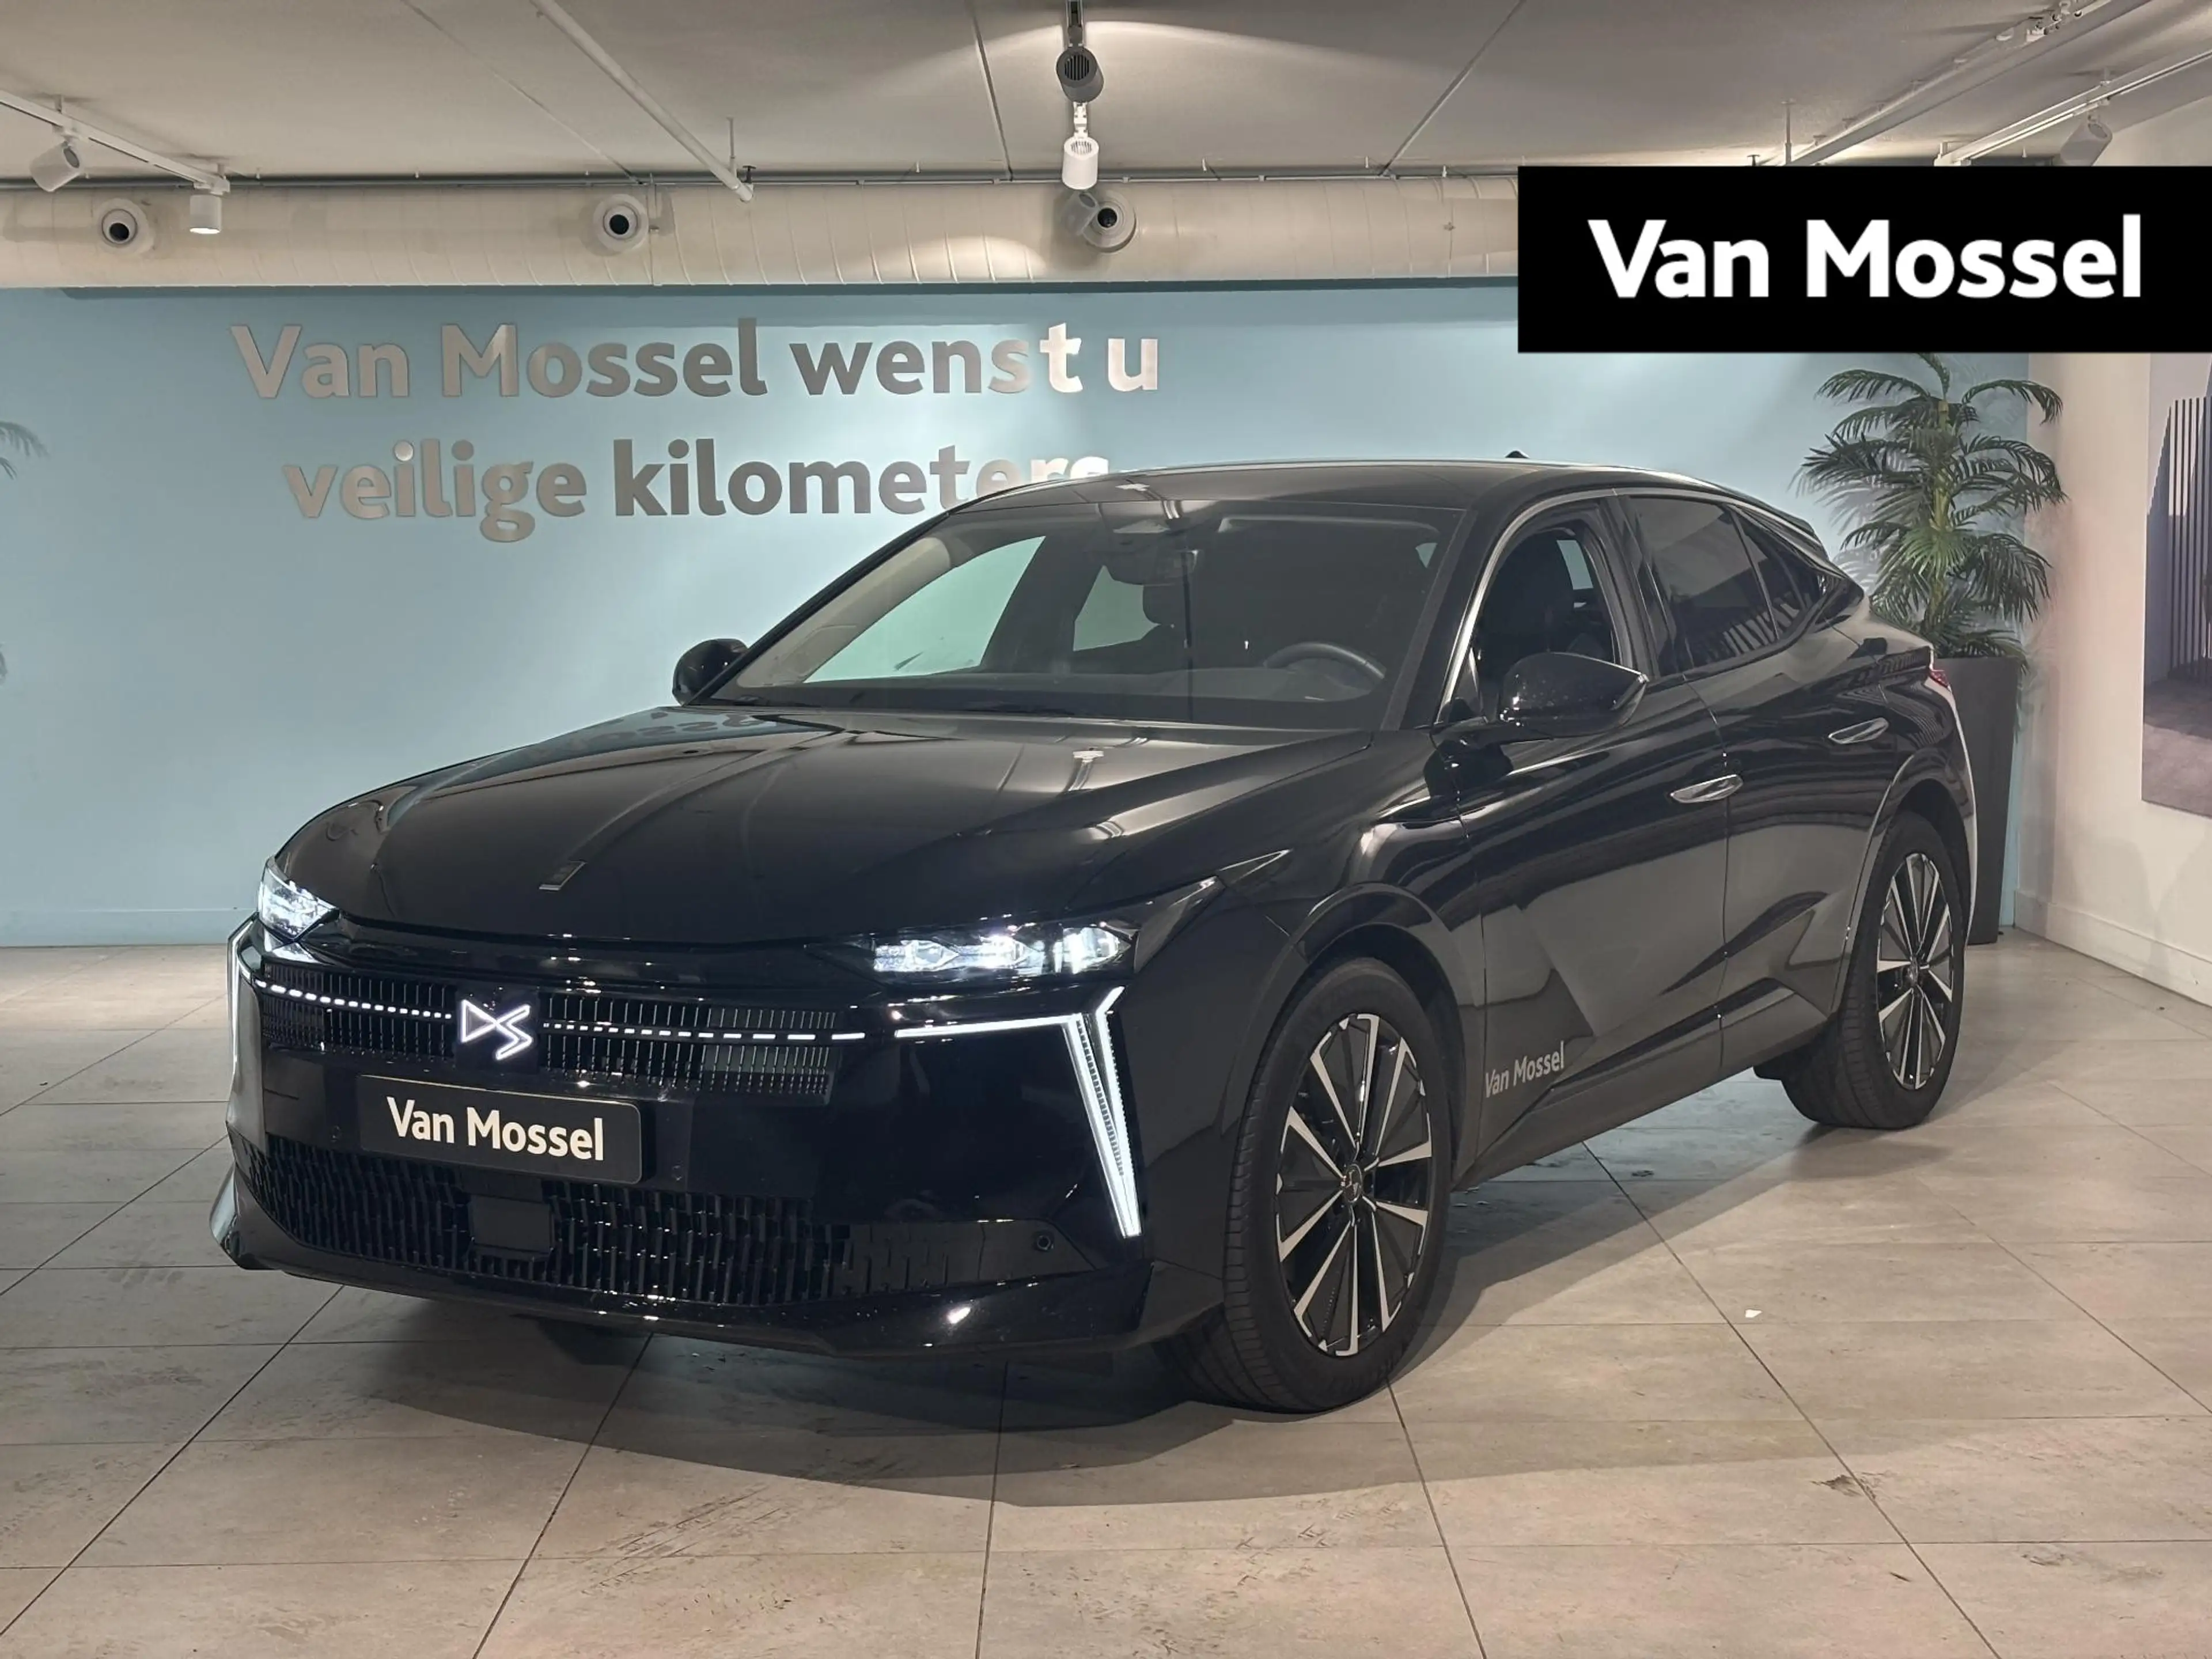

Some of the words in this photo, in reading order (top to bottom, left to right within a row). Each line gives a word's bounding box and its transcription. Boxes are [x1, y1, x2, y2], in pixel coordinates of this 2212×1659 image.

[231, 324, 410, 398] Van
[441, 317, 767, 398] Mossel
[789, 323, 1083, 396] wenst
[1108, 338, 1158, 392] u
[283, 438, 588, 543] veilige
[1485, 1069, 1509, 1098] Van
[1513, 1040, 1565, 1086] Mossel
[387, 1096, 454, 1144] Van
[467, 1106, 604, 1161] Mossel
